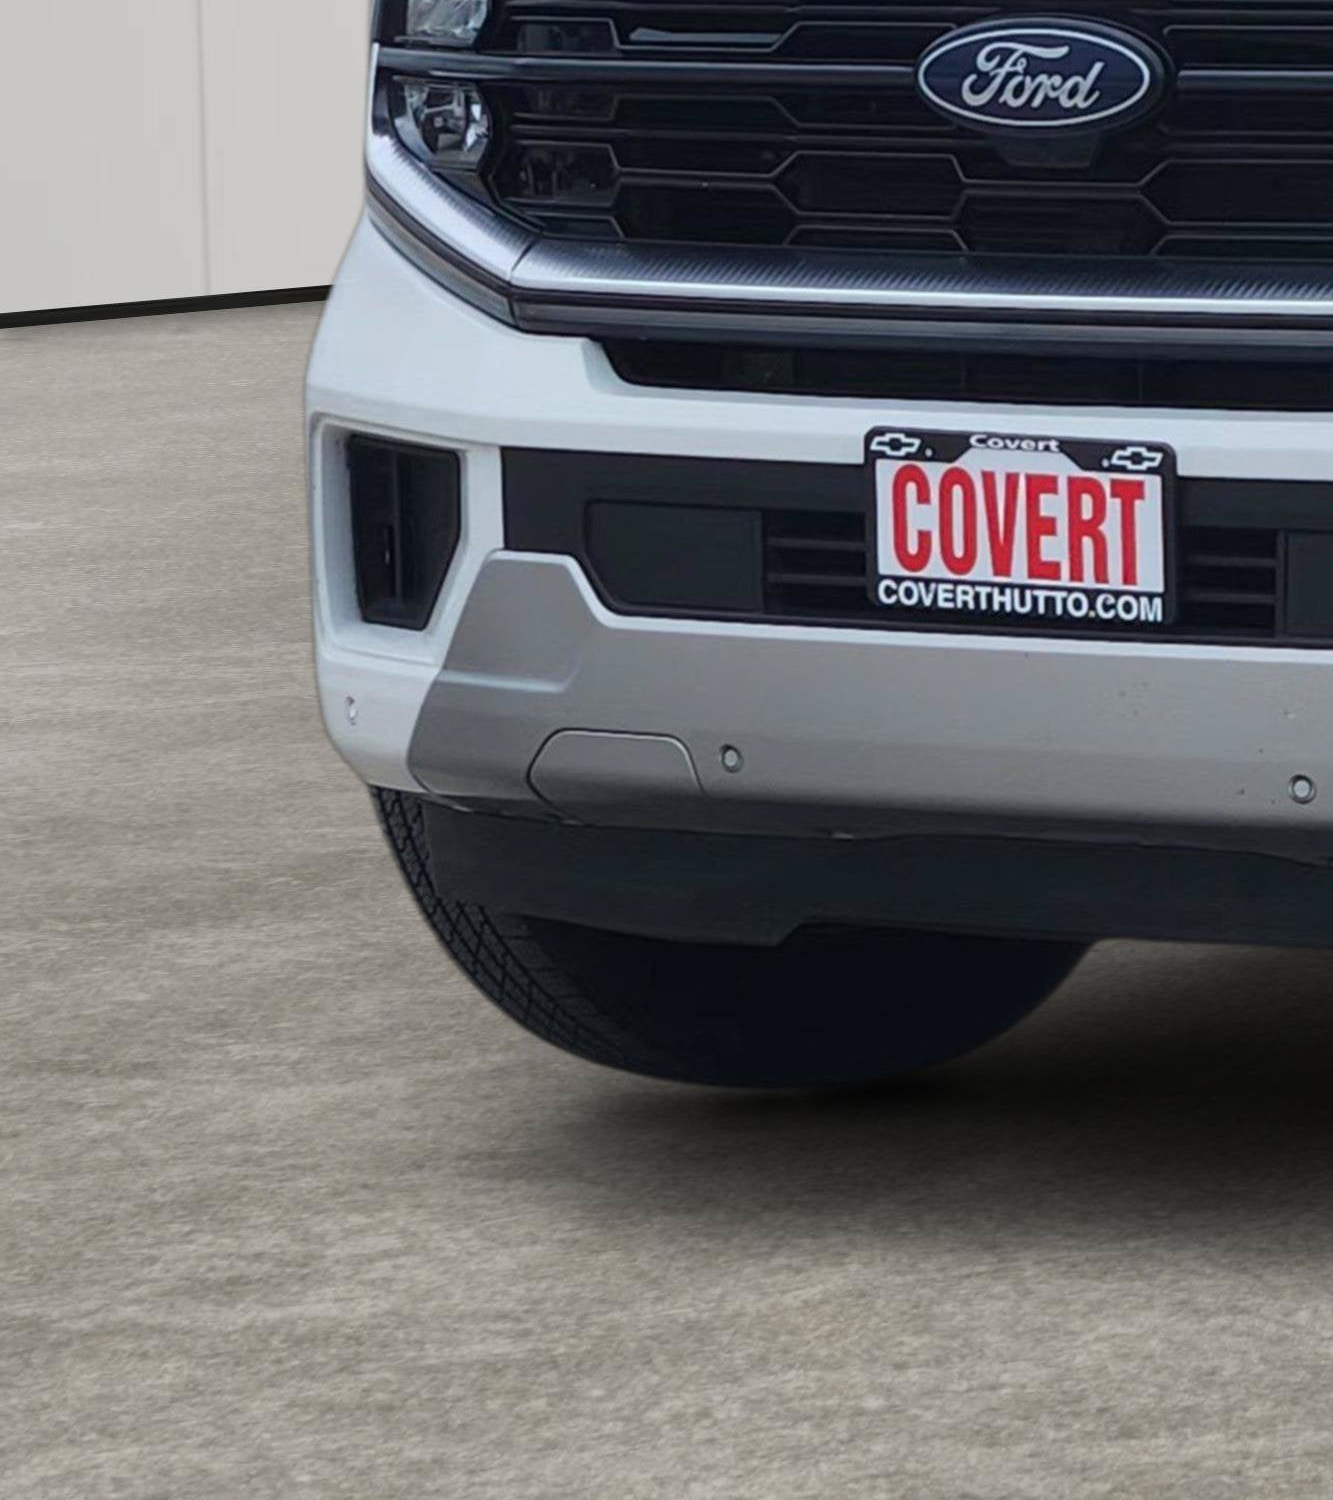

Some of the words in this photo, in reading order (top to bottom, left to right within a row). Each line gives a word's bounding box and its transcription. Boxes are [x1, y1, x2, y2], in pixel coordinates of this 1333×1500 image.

[961, 41, 1106, 111] Ford
[969, 433, 1061, 453] Covert
[892, 463, 1146, 586] COVERT
[877, 579, 1164, 623] COVERTHUTTO.COM
